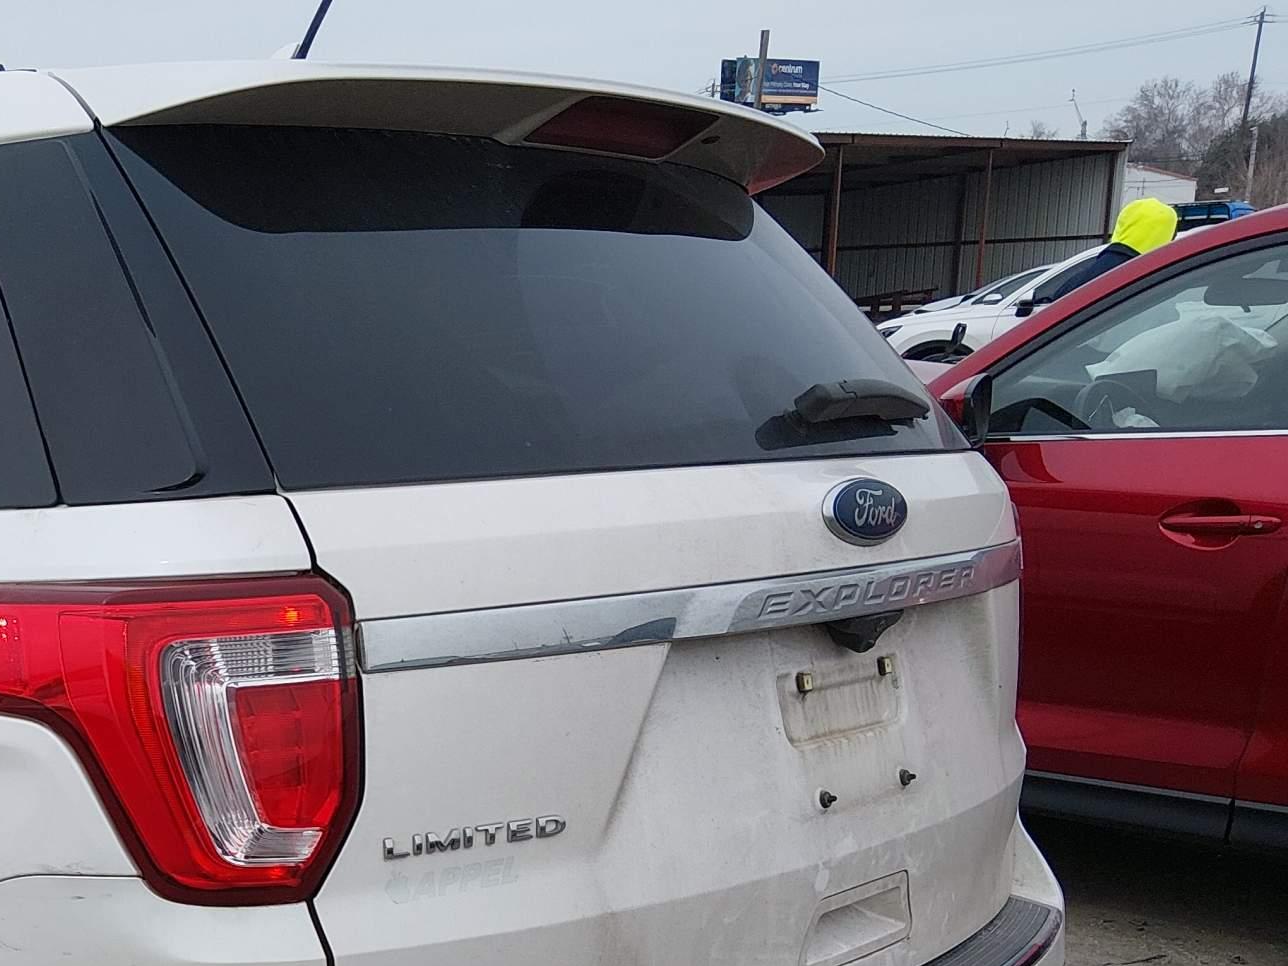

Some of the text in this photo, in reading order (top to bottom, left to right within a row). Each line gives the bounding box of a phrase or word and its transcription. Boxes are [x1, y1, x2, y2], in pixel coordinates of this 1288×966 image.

[855, 488, 899, 527] Ford
[757, 566, 974, 619] EXPLORER
[382, 814, 567, 862] LIMITED
